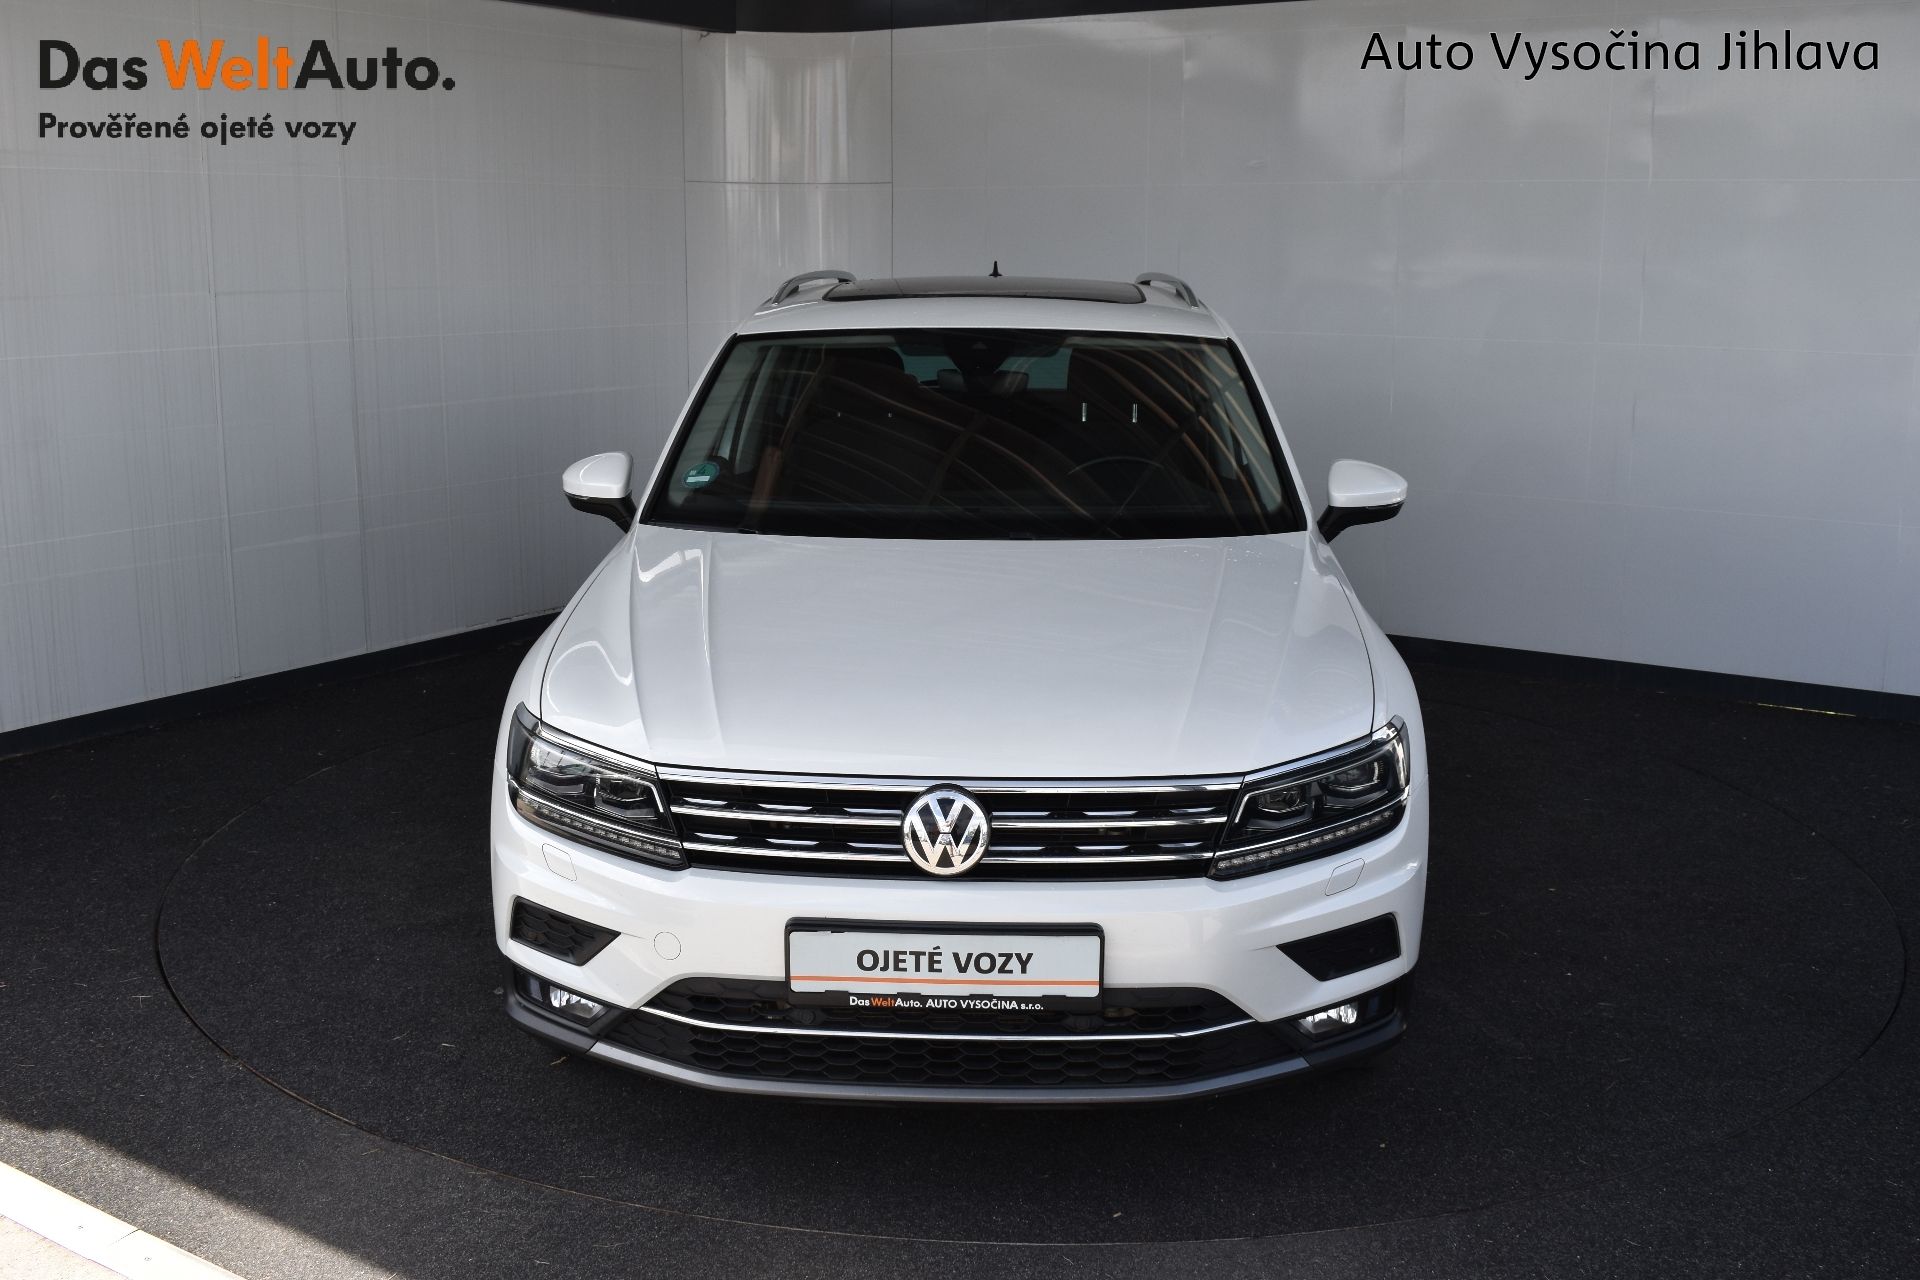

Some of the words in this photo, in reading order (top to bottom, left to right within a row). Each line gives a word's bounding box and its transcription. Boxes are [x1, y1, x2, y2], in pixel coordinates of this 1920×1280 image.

[856, 945, 943, 973] OJETÉ
[952, 951, 1034, 974] VOZY
[849, 996, 870, 1007] Das
[925, 998, 957, 1009] AUTO
[960, 998, 1018, 1010] VYSOČINA
[1020, 1001, 1044, 1011] s.r.o.
